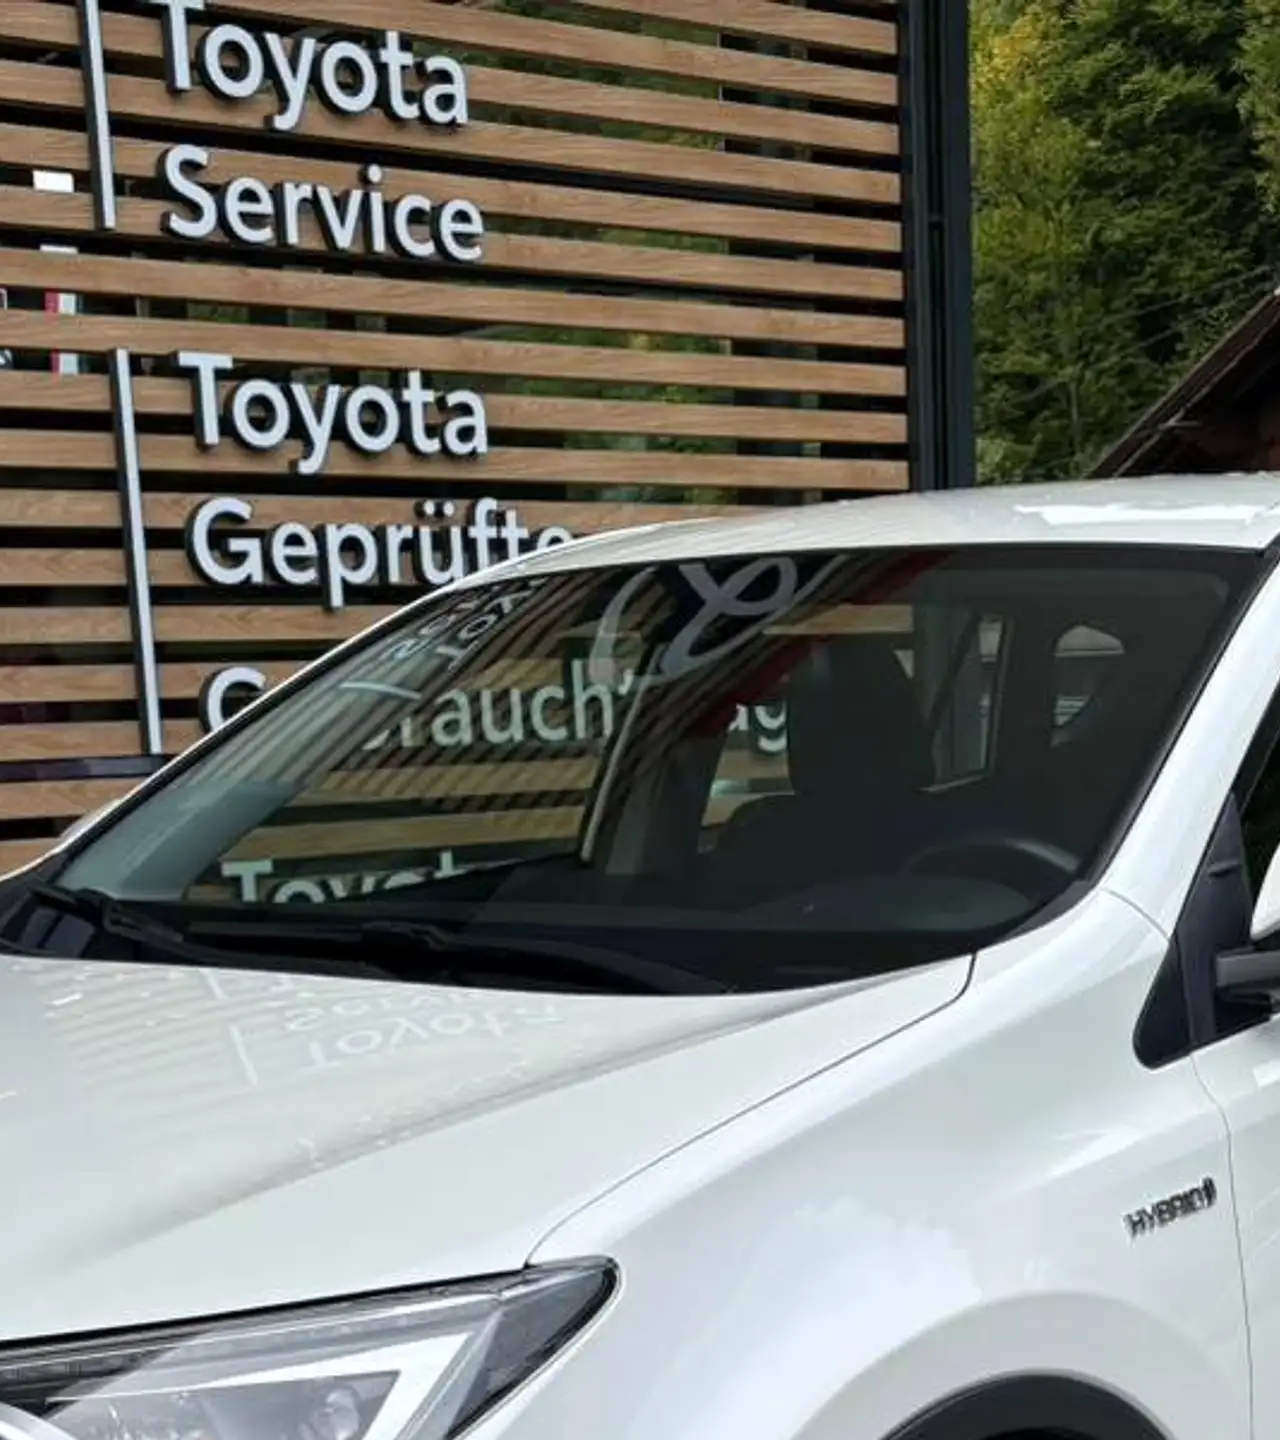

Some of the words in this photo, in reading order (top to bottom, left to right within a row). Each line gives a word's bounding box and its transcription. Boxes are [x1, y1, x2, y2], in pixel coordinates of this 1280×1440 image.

[159, 0, 469, 131] Toyota
[164, 143, 485, 262] Service
[177, 350, 489, 475] Toyota
[1122, 1186, 1207, 1240] HYBRID
